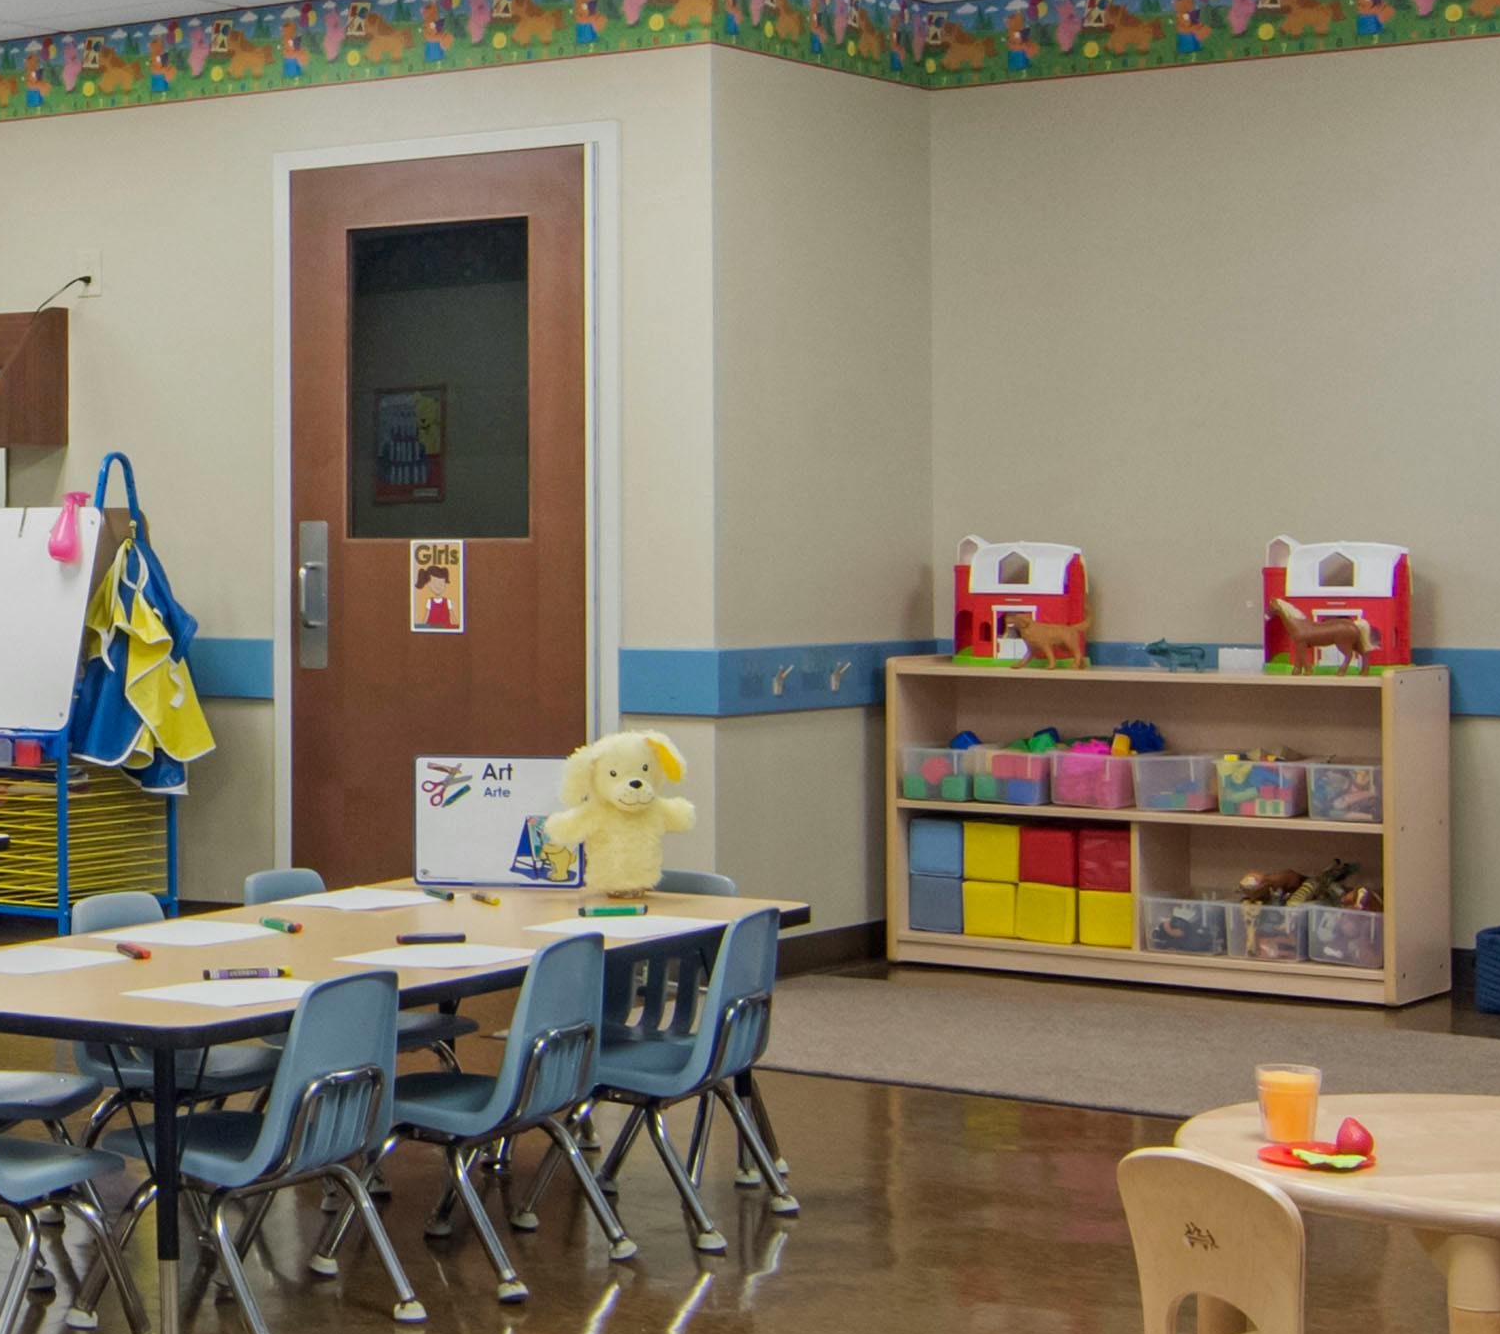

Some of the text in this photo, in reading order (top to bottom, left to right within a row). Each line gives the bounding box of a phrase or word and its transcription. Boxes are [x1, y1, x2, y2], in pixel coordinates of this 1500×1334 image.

[414, 544, 460, 566] Girls
[482, 763, 513, 781] Art
[483, 787, 511, 798] Arte
